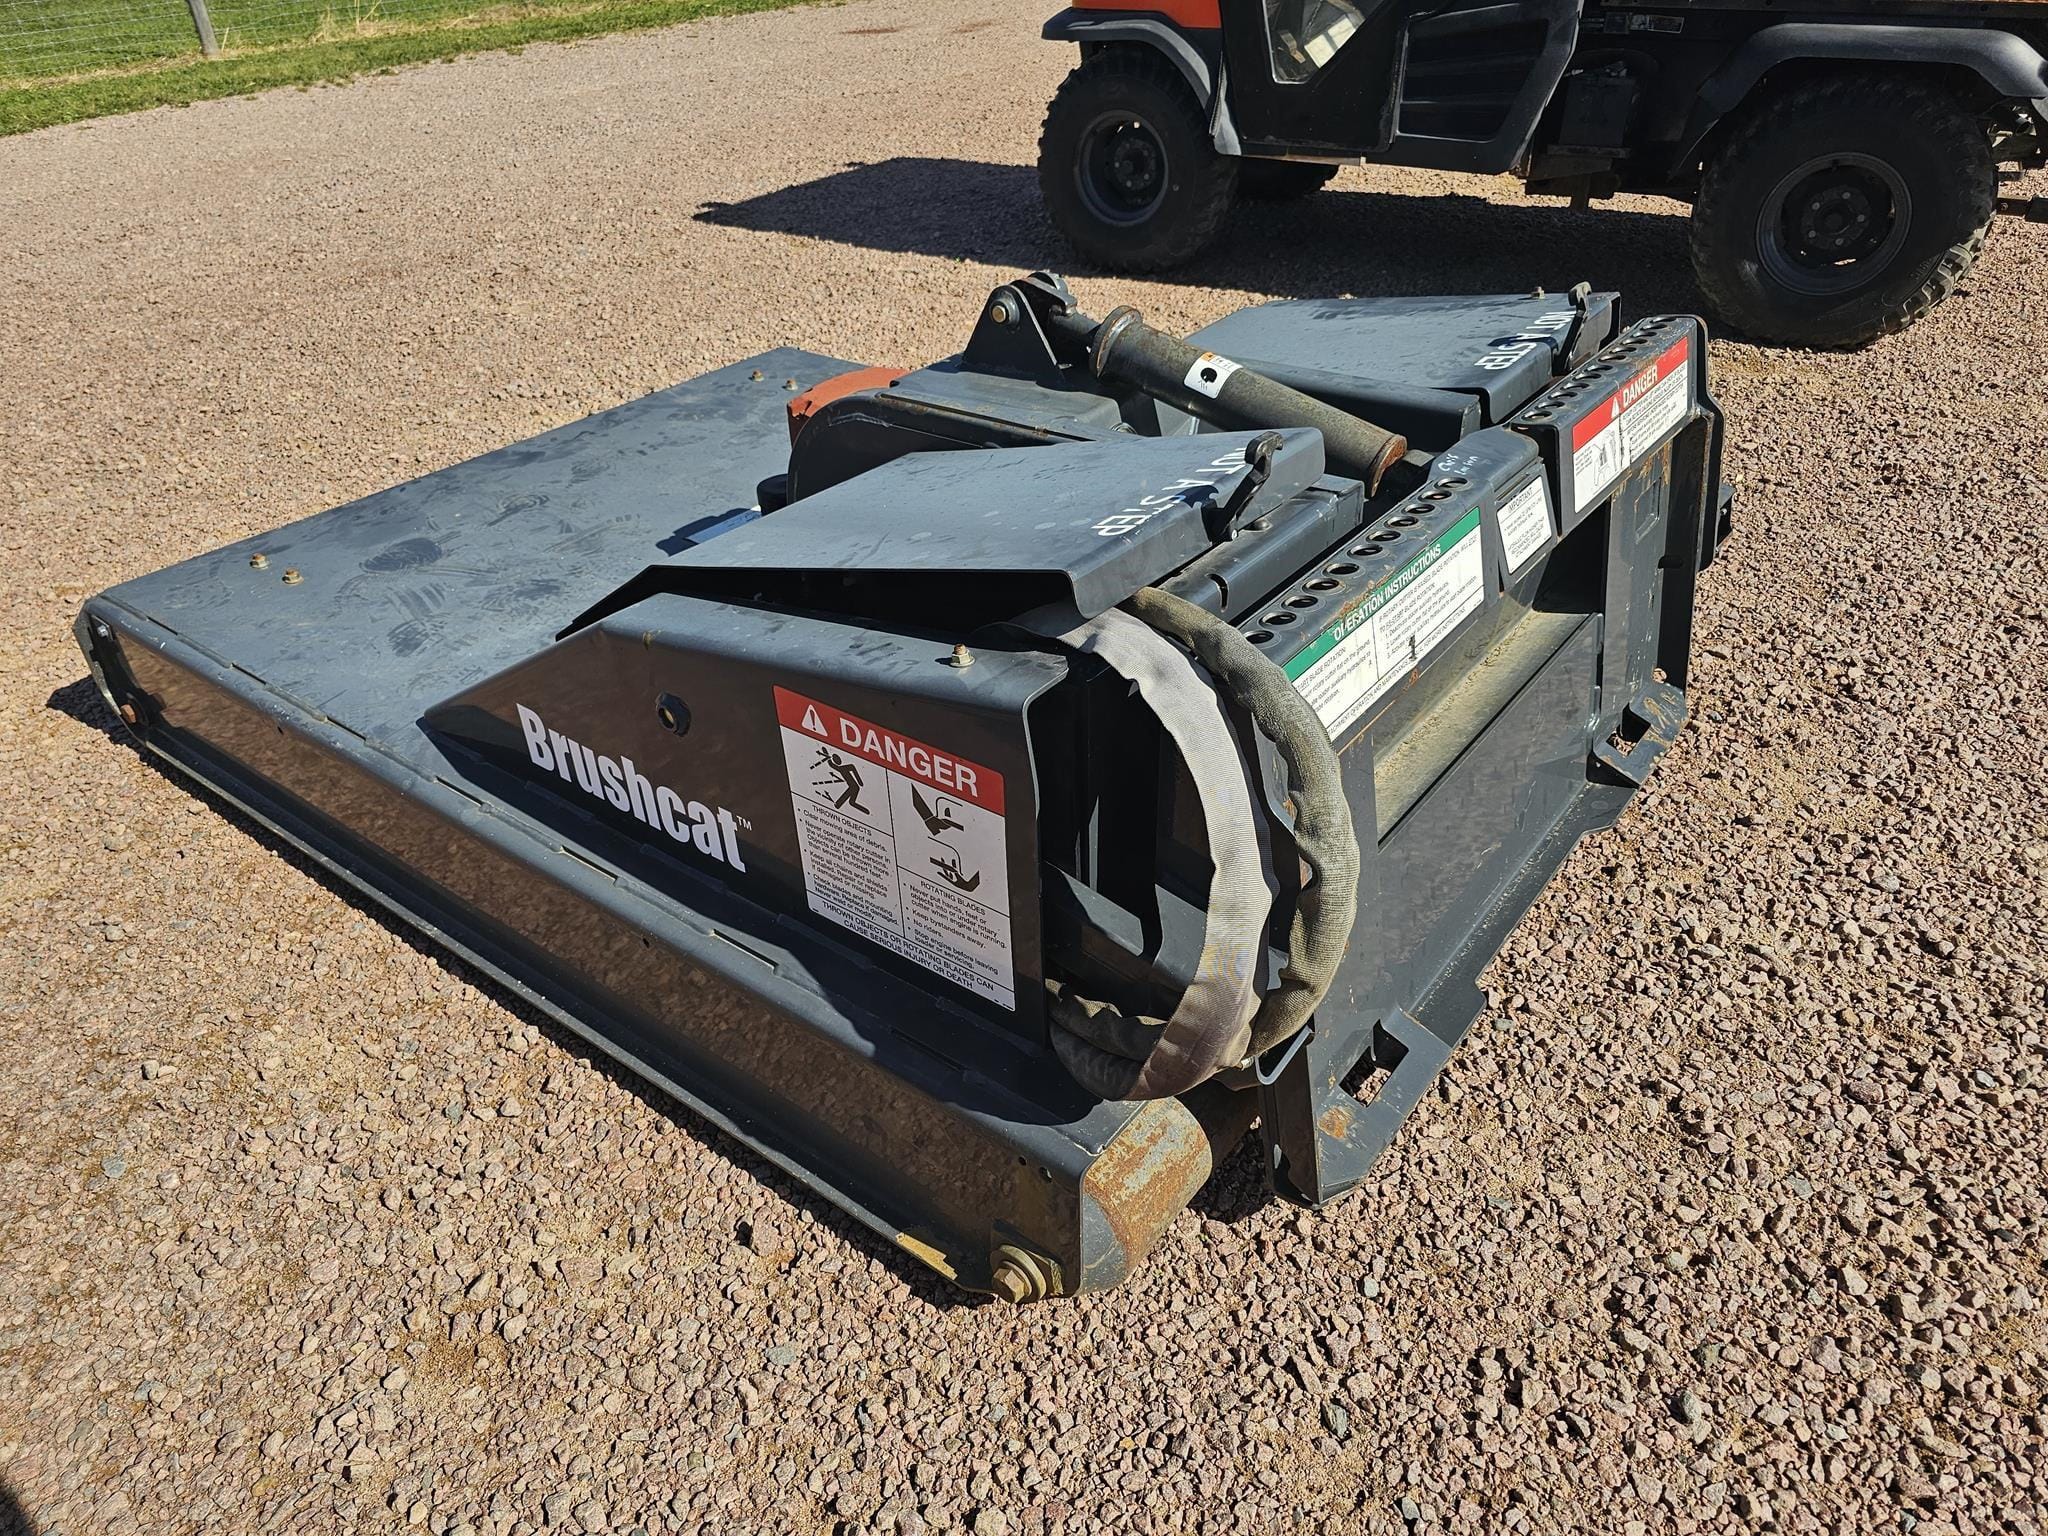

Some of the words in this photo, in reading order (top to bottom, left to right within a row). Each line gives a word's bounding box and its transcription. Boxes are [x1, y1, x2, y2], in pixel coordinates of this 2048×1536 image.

[1516, 332, 1551, 340] A
[1525, 310, 1577, 331] NOT
[1474, 341, 1537, 370] STEP
[1622, 362, 1658, 409] DANGER
[1161, 478, 1215, 491] A
[1507, 485, 1533, 513] IMPORTANT
[1382, 541, 1441, 600] INSTRUCTIONS
[838, 715, 978, 798] DANGER
[802, 808, 819, 822] Clear
[818, 815, 843, 833] mowing
[843, 826, 857, 839] area
[857, 833, 865, 843] of
[811, 804, 840, 822] THROWN
[840, 817, 872, 837] OBJECTS
[804, 819, 822, 833] Never
[822, 827, 846, 844] operate
[846, 838, 864, 853] rotary
[864, 847, 883, 861] cutter
[883, 855, 890, 865] in
[805, 826, 816, 836] the
[815, 831, 836, 846] vicinity
[837, 841, 844, 850] of
[844, 844, 861, 857] other
[806, 832, 829, 849] Objects
[829, 843, 841, 855] can
[841, 849, 850, 859] be
[850, 853, 872, 869] thrown
[872, 863, 889, 877] more
[807, 839, 821, 852] than
[821, 846, 842, 862] several
[843, 856, 868, 874] hundred
[808, 849, 824, 862] Keep
[824, 857, 832, 866] all
[832, 861, 853, 876] chains
[853, 870, 865, 882] and
[865, 876, 888, 893] shields
[812, 872, 831, 887] Check
[831, 881, 851, 897] blades
[851, 891, 864, 903] and
[863, 897, 893, 917] mounting
[909, 883, 928, 898] Never
[929, 893, 940, 904] put
[964, 909, 978, 922] feet
[979, 916, 987, 926] or
[920, 880, 956, 902] ROTATING
[956, 897, 985, 916] BLADES
[909, 891, 934, 908] objects
[934, 902, 947, 914] into
[948, 909, 956, 919] or
[957, 913, 976, 928] under
[977, 922, 997, 938] rotary
[910, 897, 930, 913] cutter
[930, 907, 948, 922] when
[949, 916, 971, 933] engine
[972, 927, 978, 936] is
[911, 908, 929, 922] Keep
[929, 916, 965, 940] bystanders
[912, 918, 923, 928] No
[821, 899, 854, 922] THROWN
[854, 915, 888, 939] OBJECTS
[890, 933, 902, 946] OR
[902, 939, 941, 966] ROTATING
[942, 959, 974, 983] BLADES
[976, 976, 994, 992] CAN
[843, 918, 869, 937] CAUSE
[869, 931, 903, 955] SERIOUS
[903, 948, 931, 969] INJURY
[932, 962, 944, 976] OR
[946, 969, 973, 990] DEATH
[913, 927, 929, 941] Stop
[930, 935, 951, 952] engine
[952, 946, 973, 963] before
[974, 957, 998, 975] leaving
[914, 934, 934, 950] loader
[935, 945, 943, 954] or
